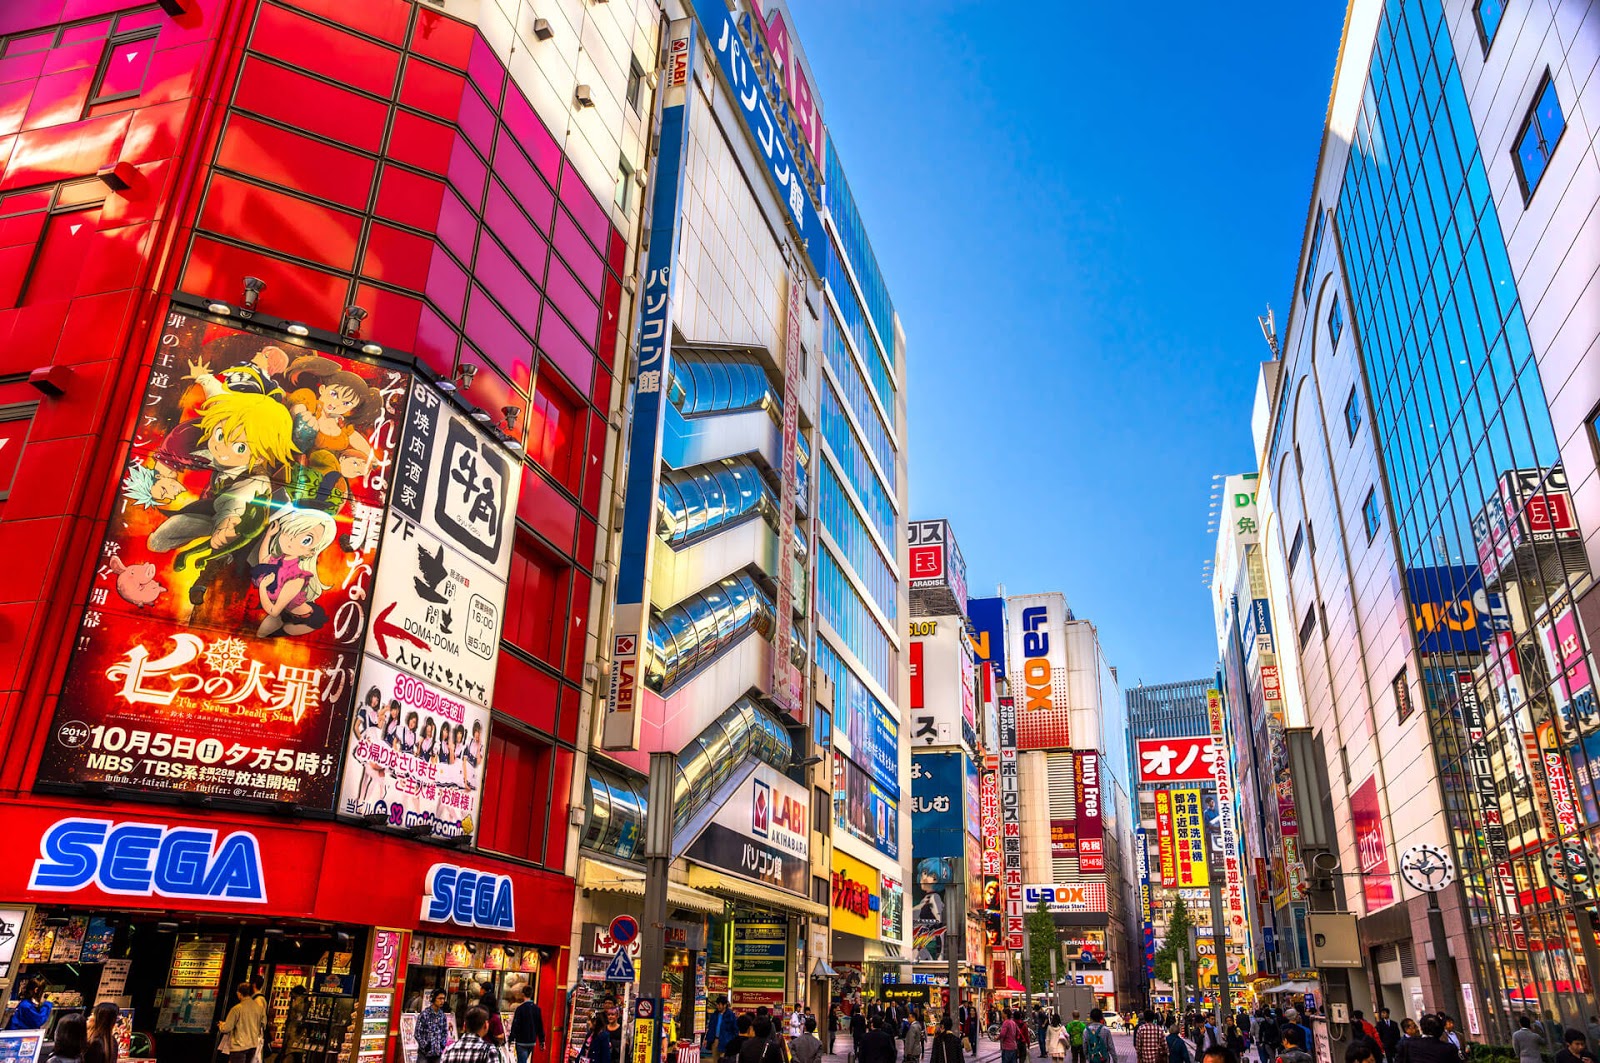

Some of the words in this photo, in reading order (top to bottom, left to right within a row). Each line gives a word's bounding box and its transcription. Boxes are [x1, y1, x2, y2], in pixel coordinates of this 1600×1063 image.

[673, 53, 687, 85] LABI
[718, 18, 804, 229] パソコン館
[637, 266, 669, 394] パソコン館
[414, 383, 440, 408] 8F
[400, 409, 431, 510] 焼肉酒家
[451, 450, 498, 536] 牛角
[391, 512, 416, 541] 7F
[1237, 517, 1257, 535] 免
[404, 617, 459, 656] DOMA-DOMA
[472, 610, 493, 630] 16:00
[1259, 642, 1270, 650] 7F
[105, 633, 322, 725] 七つの大罪
[395, 645, 488, 707] 入口はこちらです。
[609, 661, 619, 713] AKIHABARA
[617, 660, 635, 712] LABI
[176, 694, 197, 709] The
[200, 700, 230, 714] Seven
[235, 704, 268, 723] Deadly
[270, 710, 293, 723] Sins
[393, 674, 465, 724] 300万人突破!!
[60, 727, 87, 738] 2014
[68, 735, 78, 744] 年
[911, 716, 937, 737] ス
[1000, 699, 1008, 746] PARADISE
[86, 753, 198, 781] MBS/TBS系
[356, 739, 438, 781] お帰りなさいませ
[1082, 755, 1096, 785] Duty
[1215, 750, 1228, 800] TAKARADA
[234, 770, 302, 792] 放送開始!
[772, 788, 807, 838] LABI
[1084, 787, 1099, 818] Free
[406, 811, 470, 838] maidreamin
[771, 829, 807, 855] AKIHABARA
[1187, 793, 1203, 862] 冷蔵庫洗濯機
[27, 817, 268, 903] SEGA
[742, 843, 782, 881] パソコン館
[1002, 763, 1023, 948] ボークス秋葉原ホビー天国
[1081, 841, 1100, 851] 免税
[1137, 834, 1148, 878] Panasonic
[1161, 836, 1174, 877] DUTYFREE
[1360, 820, 1381, 870] atré
[420, 863, 515, 932] SEGA
[1142, 884, 1151, 922] ONODEN
